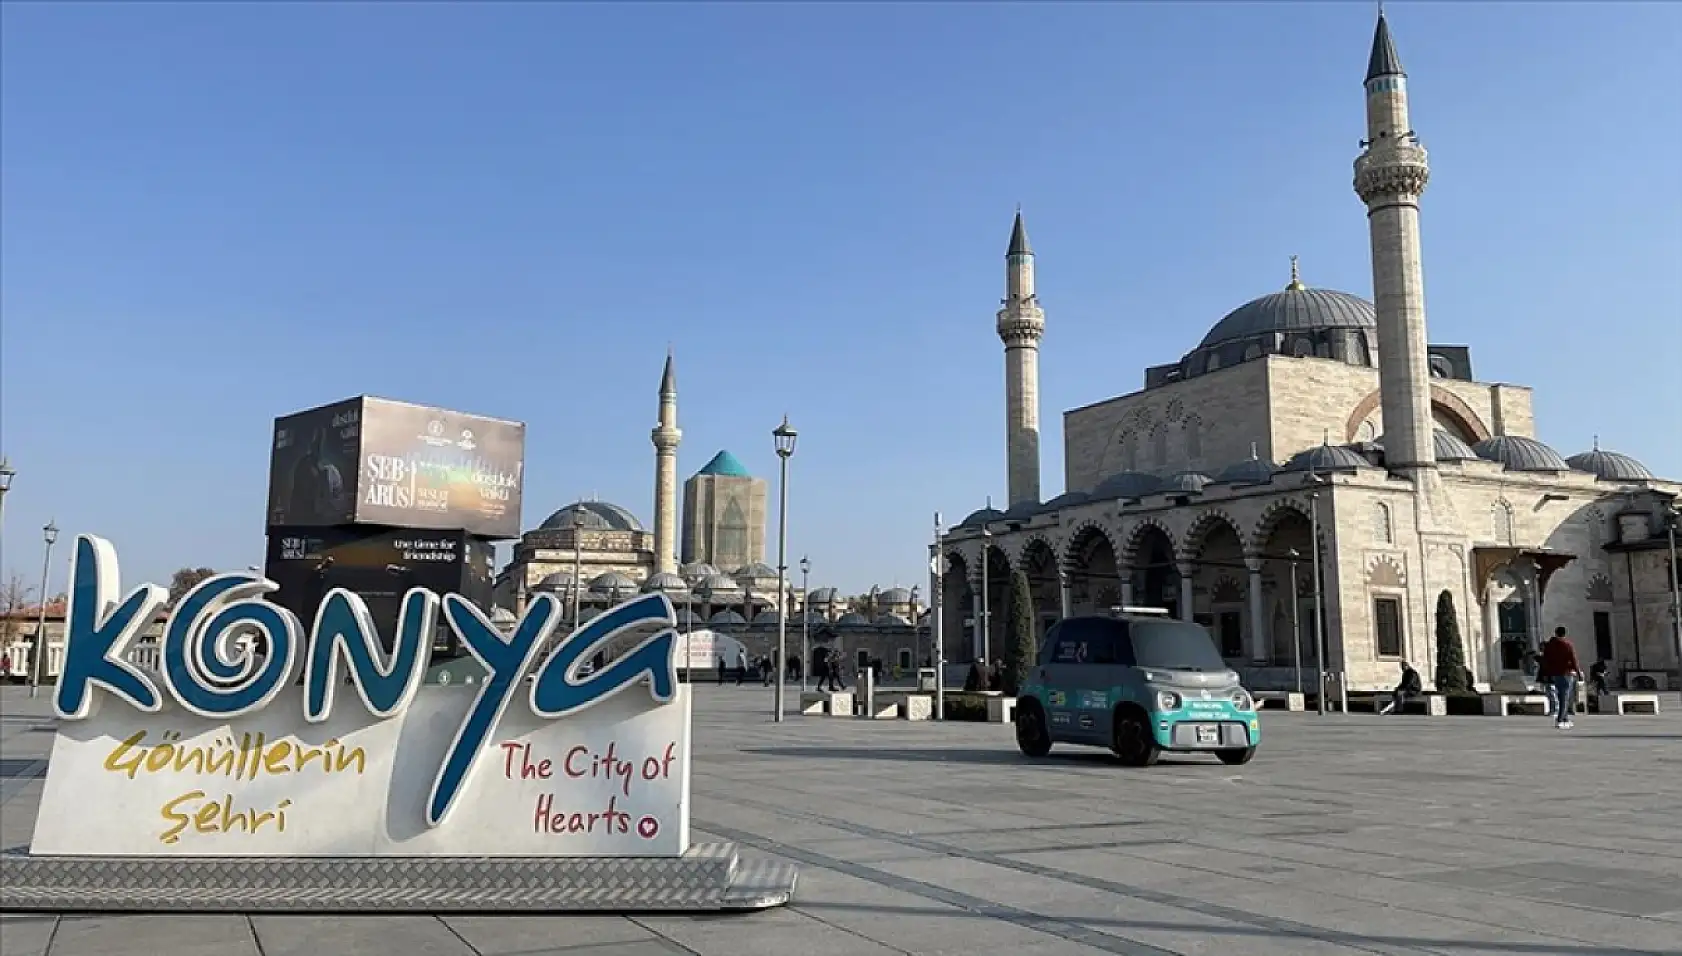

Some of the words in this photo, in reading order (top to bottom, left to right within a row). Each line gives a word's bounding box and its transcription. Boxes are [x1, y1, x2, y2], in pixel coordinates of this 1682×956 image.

[104, 730, 366, 778] Gönüllerin
[501, 742, 552, 779] The
[564, 745, 632, 795] City
[643, 740, 676, 779] of
[160, 792, 292, 844] Şehri
[534, 794, 630, 834] Hearts
